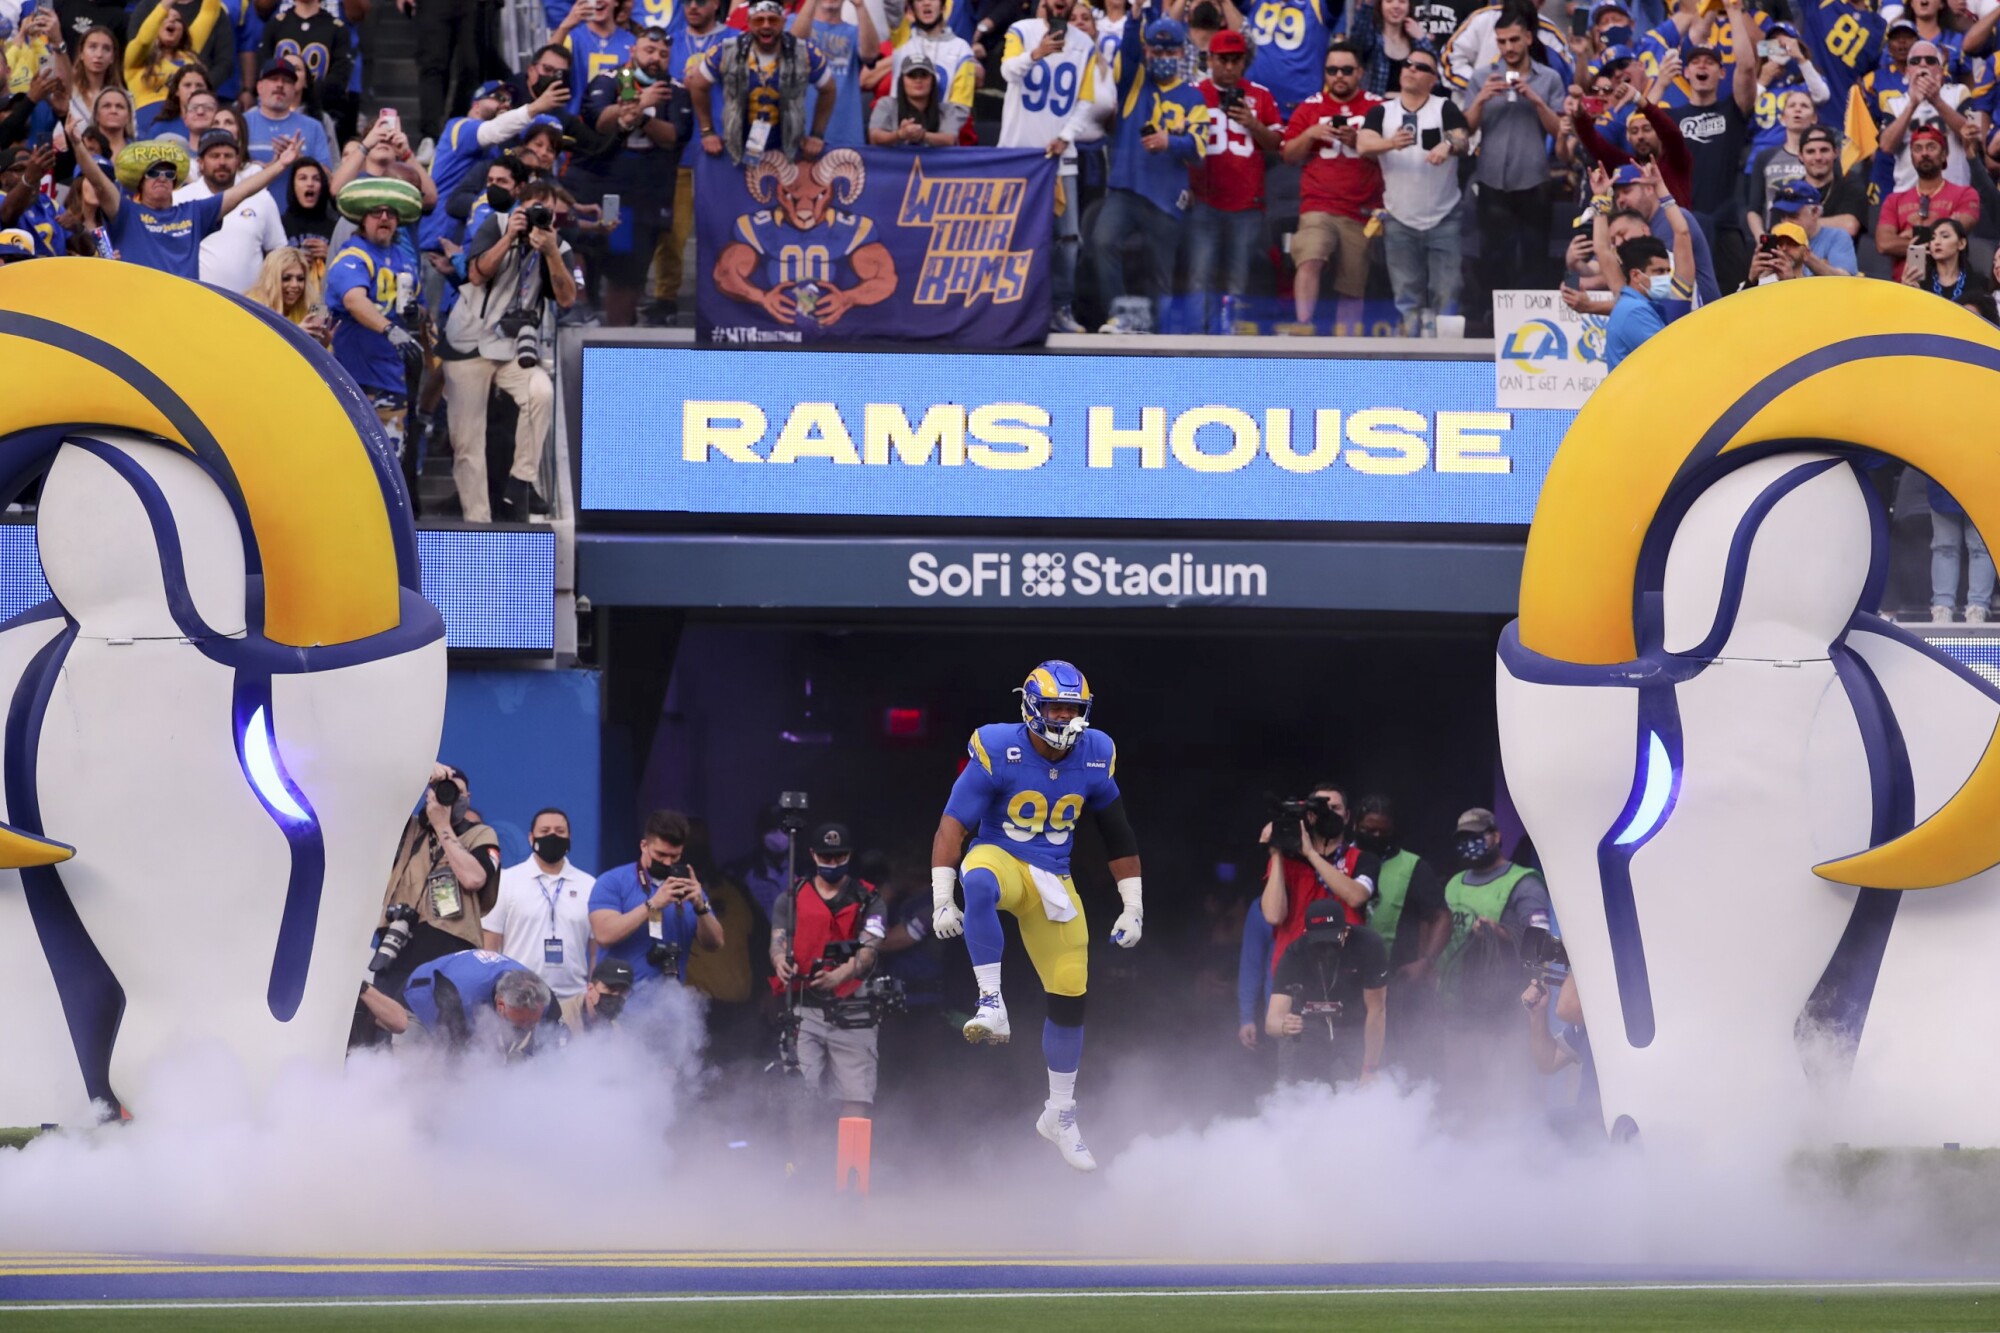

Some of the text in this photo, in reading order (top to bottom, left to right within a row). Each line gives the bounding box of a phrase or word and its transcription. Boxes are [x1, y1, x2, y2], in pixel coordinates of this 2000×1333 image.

[1252, 2, 1305, 50] 99
[1825, 13, 1870, 68] 81
[1021, 58, 1077, 117] 99
[897, 155, 1028, 227] WORLD
[930, 217, 1014, 253] TOUR
[913, 249, 1034, 308] RAMS
[1499, 374, 1523, 391] CAN
[1526, 376, 1536, 391] I
[1538, 375, 1558, 391] GET
[1562, 376, 1576, 391] A
[682, 400, 1512, 475] RAMS HOUSE
[908, 552, 1267, 597] SoFi Stadium
[1006, 747, 1022, 760] C
[1002, 789, 1085, 845] 99
